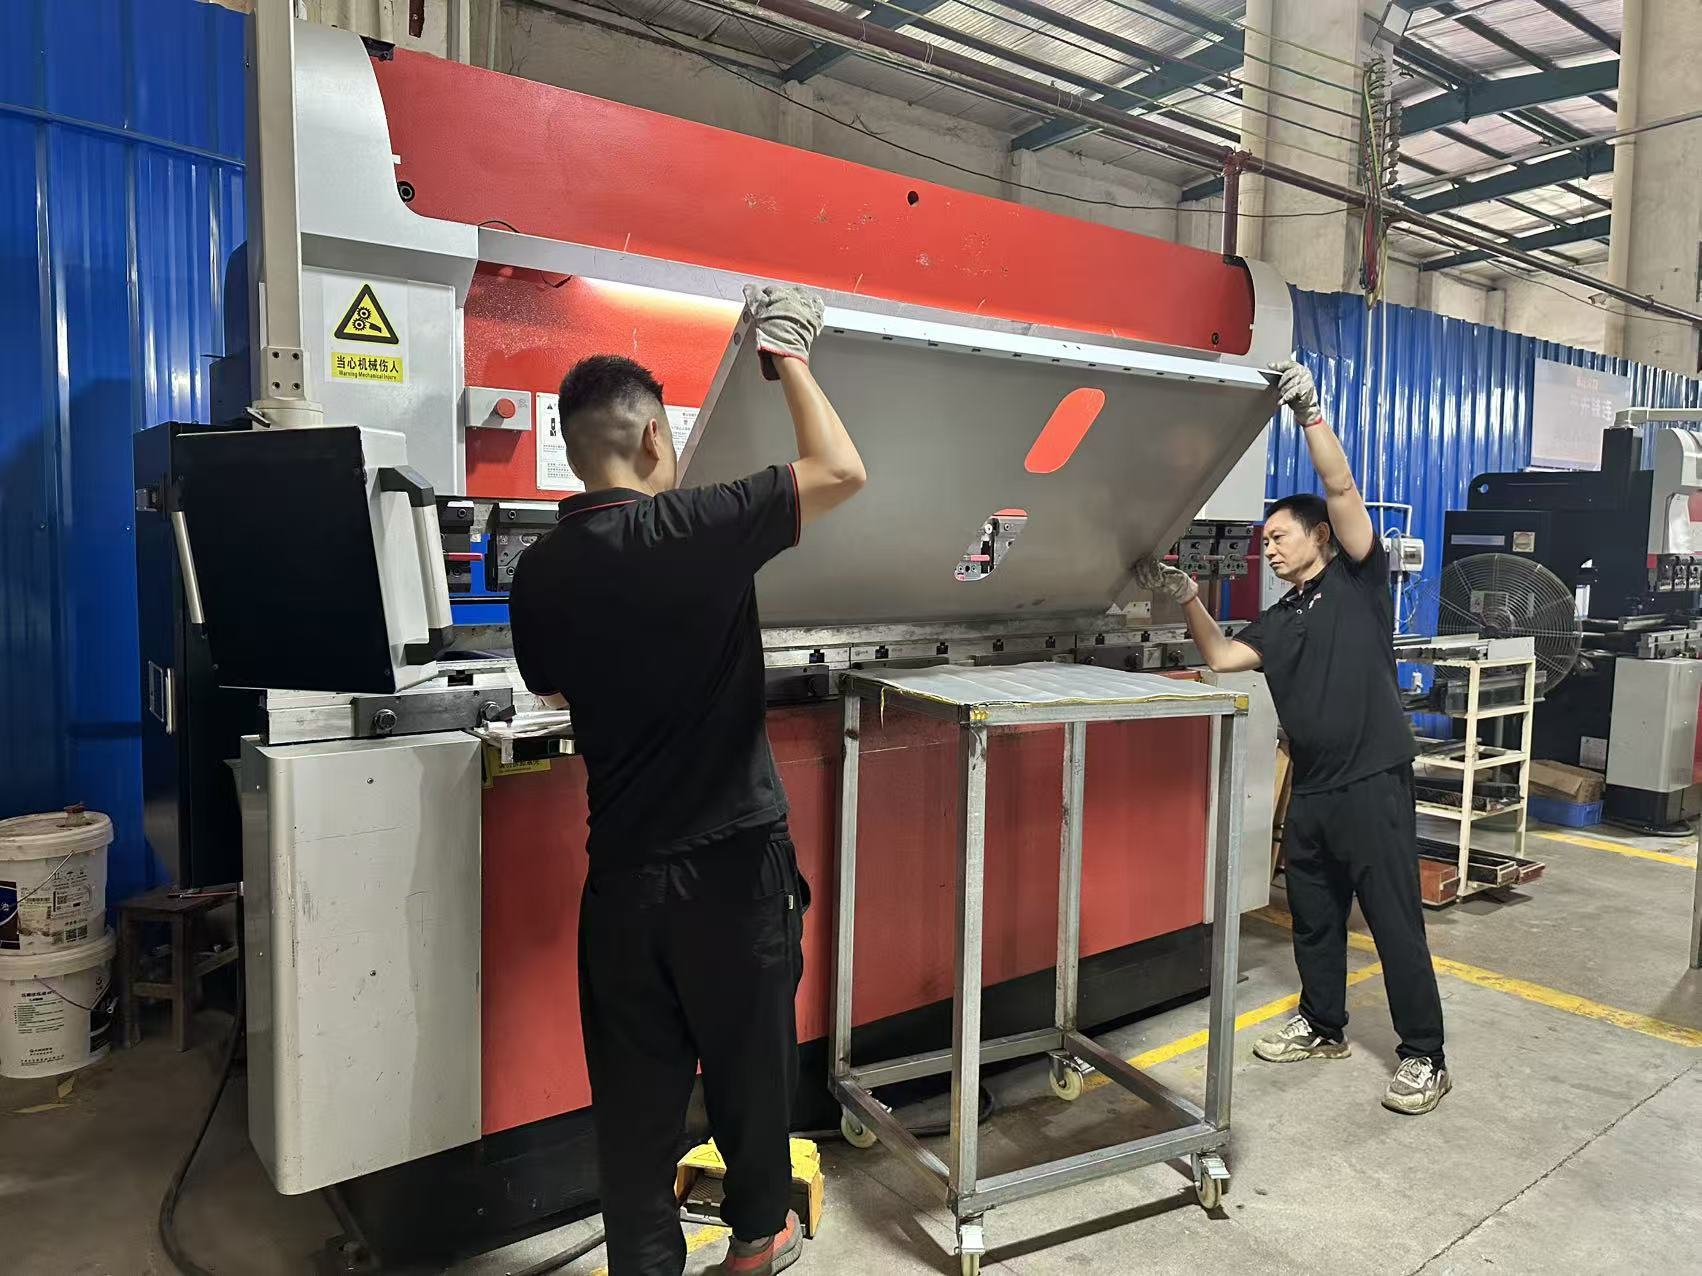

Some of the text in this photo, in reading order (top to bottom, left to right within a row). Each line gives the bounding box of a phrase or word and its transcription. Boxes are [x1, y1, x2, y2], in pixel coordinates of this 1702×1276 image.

[336, 355, 398, 373] 当心机械伤人
[338, 370, 358, 378] Warning
